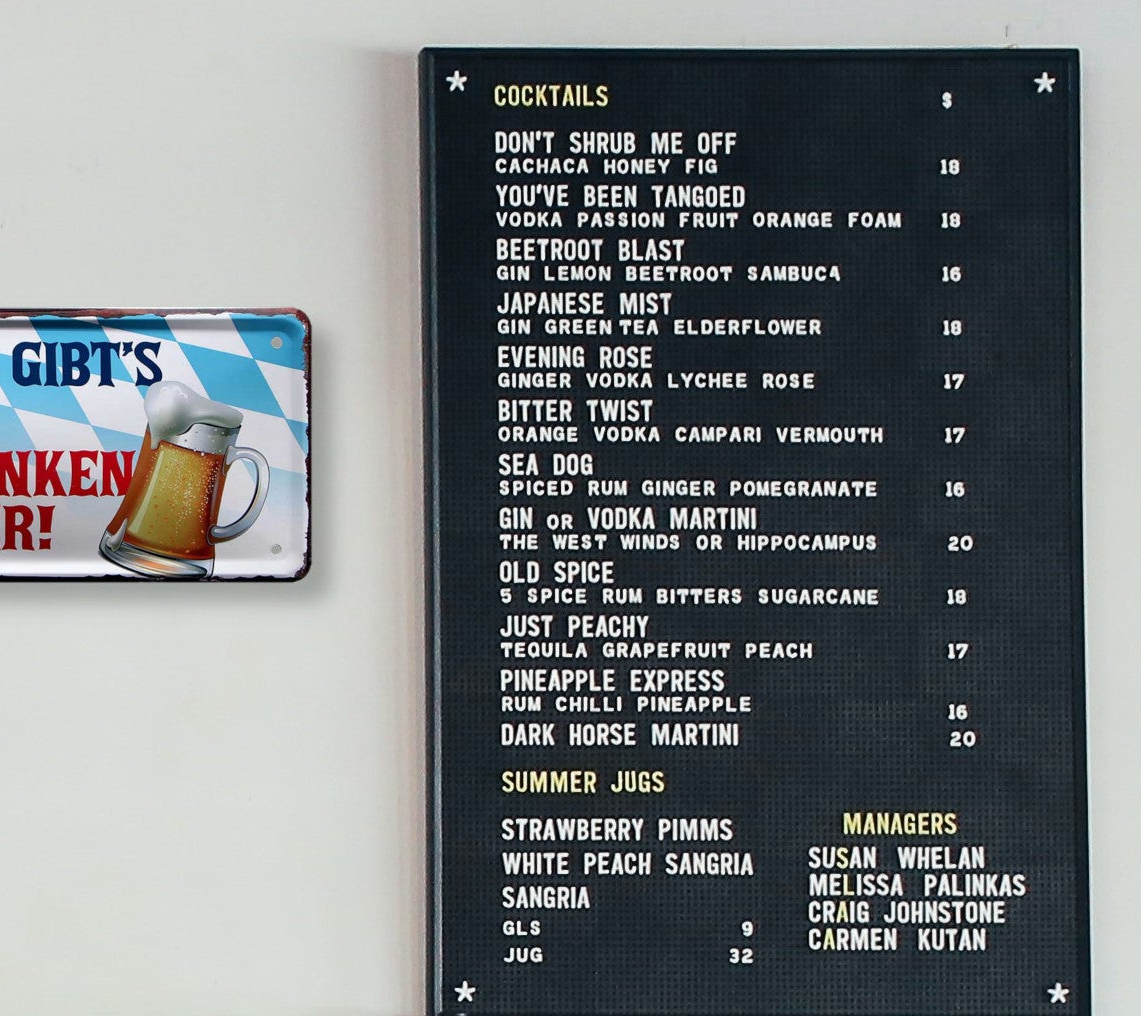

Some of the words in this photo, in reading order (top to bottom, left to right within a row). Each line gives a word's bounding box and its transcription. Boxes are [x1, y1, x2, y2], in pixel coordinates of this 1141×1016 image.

[494, 84, 608, 107] COCKTAILS
[494, 130, 555, 154] DON'T
[569, 131, 636, 155] SHRUB
[651, 131, 683, 155] ME
[697, 131, 737, 155] OFF
[495, 157, 589, 174] CACHACA
[603, 158, 670, 175] HONEY
[685, 158, 718, 175] FIG
[940, 159, 960, 175] 18
[495, 183, 569, 207] YOU'VE
[583, 184, 637, 208] BEEN
[651, 184, 745, 208] TANGOED
[495, 211, 563, 228] VODKA
[577, 211, 665, 228] PASSION
[679, 212, 739, 228] FRUIT
[752, 211, 833, 228] ORANGE
[848, 211, 902, 229] FOAM
[941, 212, 961, 229] 18
[496, 238, 603, 262] BEETROOT
[618, 238, 685, 262] BLAST
[496, 265, 530, 282] GIN
[544, 265, 612, 282] LEMON
[625, 265, 733, 282] BEETROOT
[747, 265, 841, 282] SAMBUCA
[942, 266, 962, 282] 16
[496, 291, 604, 315] JAPANESE
[619, 292, 672, 316] MIST
[497, 318, 531, 335] GIN
[544, 318, 612, 335] GREEN
[618, 319, 659, 336] TEA
[673, 319, 821, 336] ELDERFLOWER
[943, 319, 962, 336] 18
[11, 341, 163, 387] GIBT'S
[497, 345, 585, 369] EVENING
[599, 345, 653, 369] ROSE
[497, 372, 572, 389] GINGER
[585, 372, 653, 389] VODKA
[667, 372, 748, 389] LYCHEE
[762, 372, 815, 390] ROSE
[943, 373, 965, 390] 17
[498, 399, 572, 423] BITTER
[586, 399, 653, 423] TWIST
[498, 426, 578, 443] ORANGE
[593, 426, 660, 443] VODKA
[675, 426, 762, 443] CAMPARI
[776, 426, 883, 444] VERMOUTH
[944, 427, 966, 444] 17
[498, 453, 539, 476] SEA
[553, 453, 593, 476] DOG
[499, 479, 574, 496] SPICED
[587, 480, 628, 497] RUM
[641, 479, 716, 497] GINGER
[729, 480, 877, 498] POMEGRANATE
[945, 481, 965, 498] 16
[499, 506, 533, 530] GIN
[546, 513, 573, 531] OR
[587, 506, 656, 530] VODKA
[669, 506, 757, 531] MARTINI
[499, 534, 539, 550] THE
[552, 534, 607, 551] WEST
[619, 533, 680, 550] WINDS
[695, 534, 723, 551] OR
[737, 534, 877, 551] HIPPOCAMPUS
[947, 535, 974, 552] 20
[499, 560, 540, 584] OLD
[553, 560, 614, 584] SPICE
[500, 588, 512, 604] 5
[527, 587, 587, 604] SPICE
[602, 587, 643, 605] RUM
[656, 588, 742, 605] BITTERS
[758, 588, 879, 606] SUGARCANE
[947, 588, 967, 605] 18
[499, 614, 554, 638] JUST
[568, 615, 649, 638] PEACHY
[500, 641, 588, 659] TEQUILA
[602, 642, 731, 659] GRAPEFRUIT
[745, 642, 813, 659] PEACH
[947, 643, 969, 660] 17
[500, 668, 616, 692] PINEAPPLE
[630, 669, 725, 693] EXPRESS
[501, 696, 542, 712] RUM
[555, 696, 622, 713] CHILLI
[637, 696, 752, 713] PINEAPPLE
[948, 703, 968, 720] 16
[501, 723, 555, 746] DARK
[569, 723, 636, 746] HORSE
[651, 723, 739, 746] MARTINI
[949, 730, 976, 748] 20
[501, 770, 597, 794] SUMMER
[610, 770, 665, 793] JUGS
[501, 818, 644, 842] STRAWBERRY
[658, 818, 733, 842] PIMMS
[843, 812, 957, 835] MANAGERS
[502, 852, 570, 875] WHITE
[584, 852, 652, 876] PEACH
[665, 852, 754, 876] SANGRIA
[808, 846, 877, 869] SUSAN
[897, 846, 985, 870] WHELAN
[809, 873, 904, 897] MELISSA
[924, 873, 1026, 897] PALINKAS
[502, 885, 590, 909] SANGRIA
[808, 900, 870, 924] CRAIG
[883, 900, 1006, 924] JOHNSTONE
[502, 920, 541, 936] GLS
[741, 921, 754, 937] 9
[808, 927, 897, 951] CARMEN
[918, 927, 986, 952] KUTAN
[503, 947, 543, 963] JUG
[729, 948, 754, 964] 32
